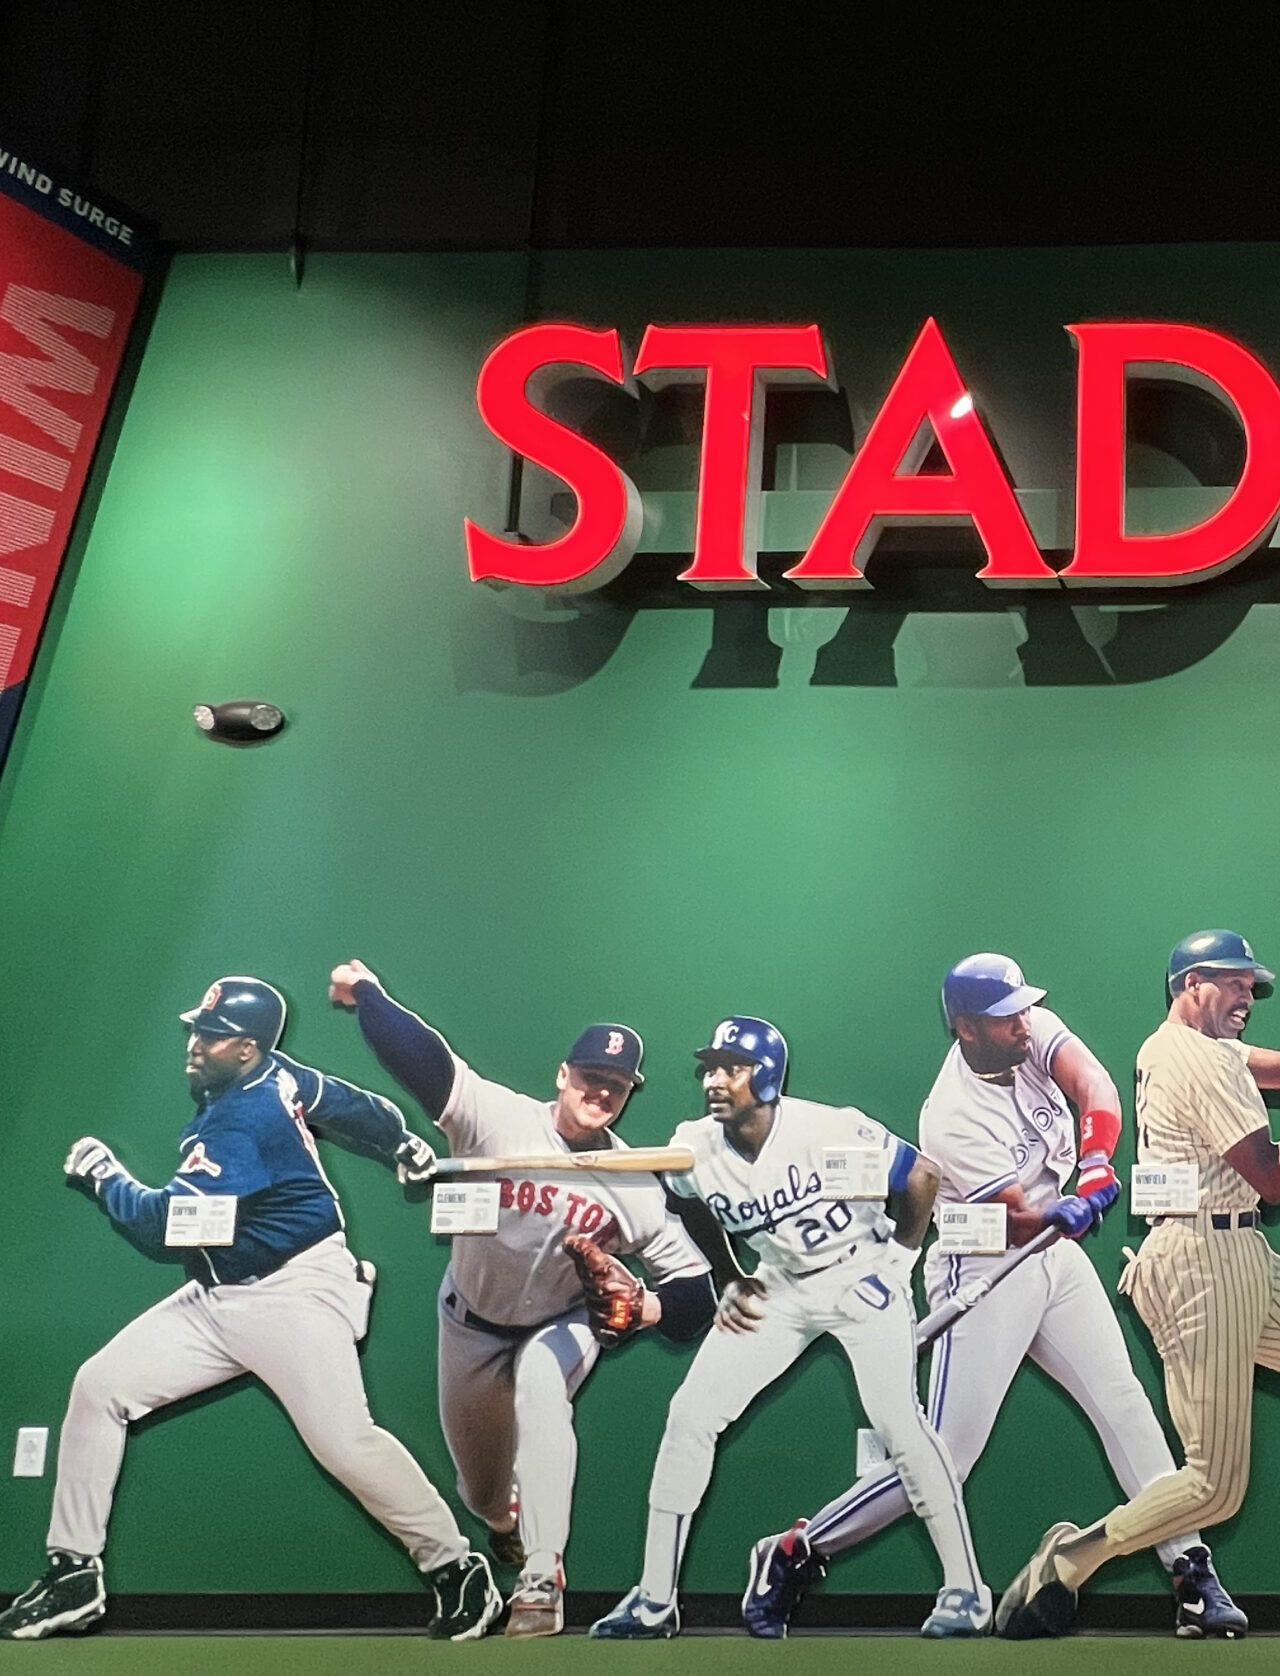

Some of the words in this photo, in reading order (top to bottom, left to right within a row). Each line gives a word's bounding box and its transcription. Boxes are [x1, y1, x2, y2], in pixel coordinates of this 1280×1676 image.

[58, 187, 134, 246] SURGE
[605, 1030, 625, 1056] B
[825, 1159, 848, 1170] WHITE
[1135, 1173, 1167, 1185] WINFIELD
[436, 1192, 467, 1204] CLEMENS
[707, 1164, 822, 1234] Royals
[796, 1200, 853, 1250] 20
[942, 1213, 969, 1224] CARTER
